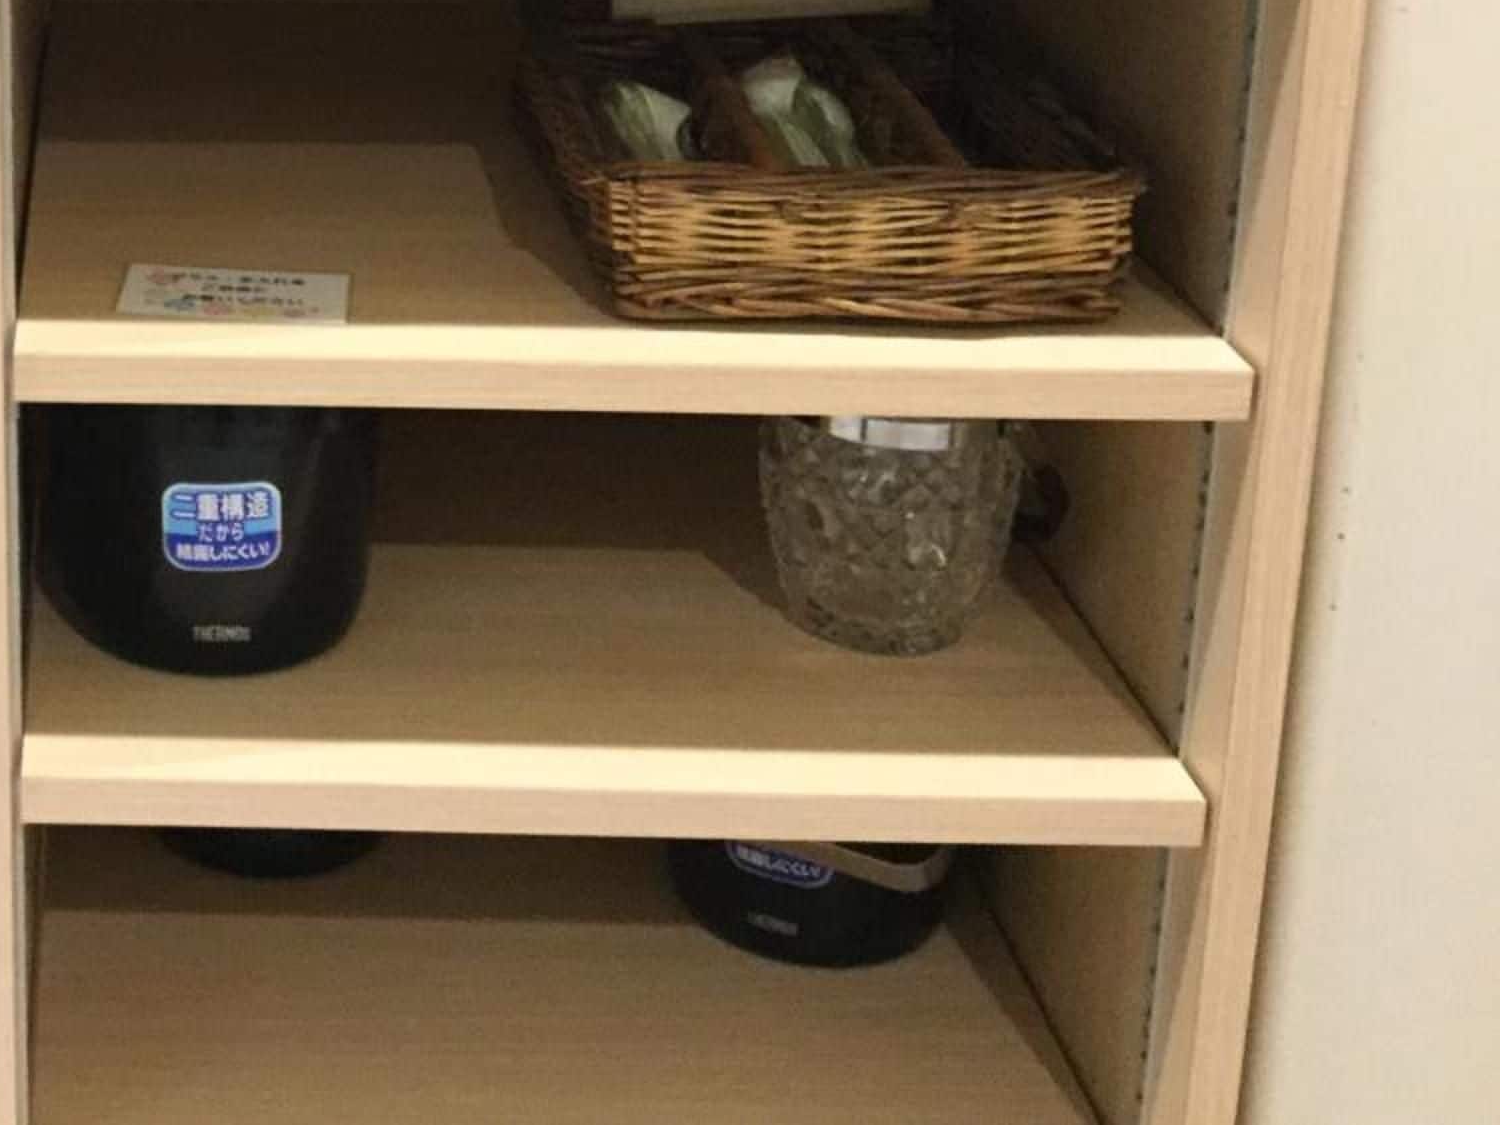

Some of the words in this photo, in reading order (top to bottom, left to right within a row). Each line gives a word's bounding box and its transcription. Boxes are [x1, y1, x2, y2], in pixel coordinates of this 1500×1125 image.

[171, 491, 269, 521] 二重構造
[200, 523, 245, 542] だから
